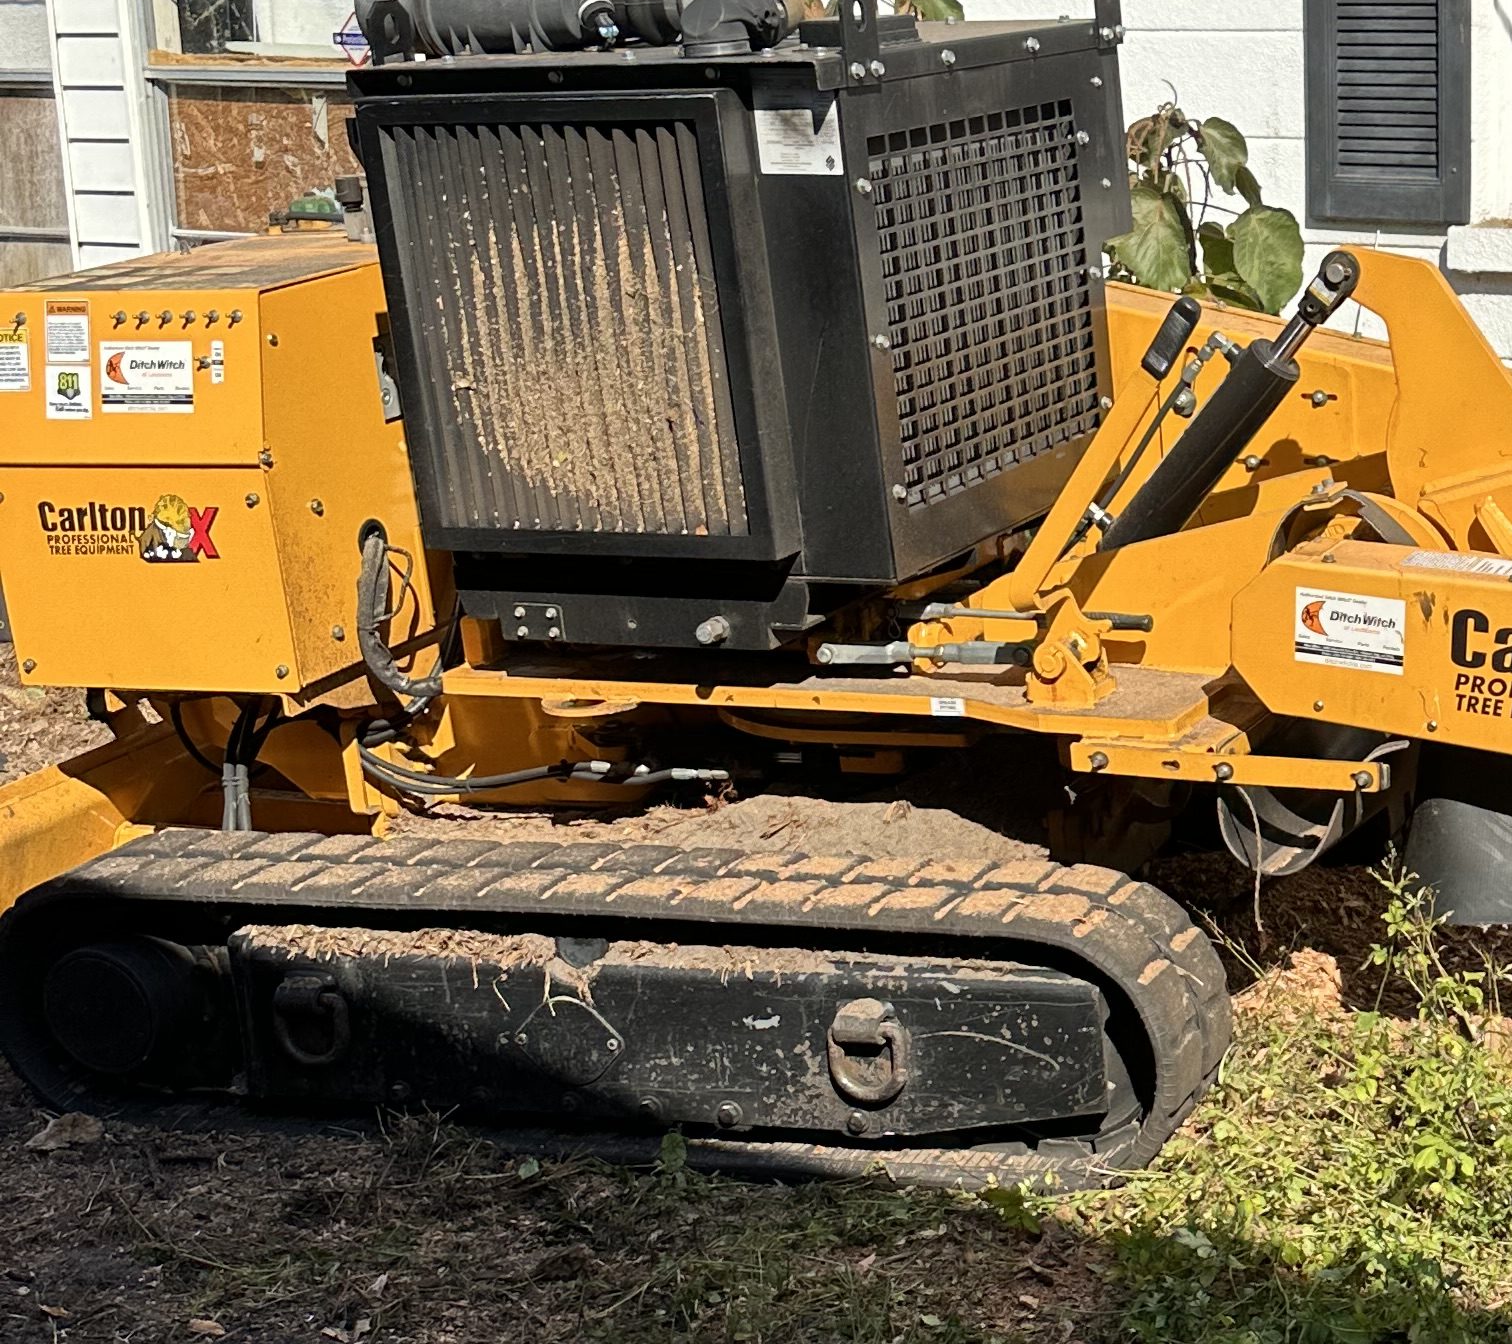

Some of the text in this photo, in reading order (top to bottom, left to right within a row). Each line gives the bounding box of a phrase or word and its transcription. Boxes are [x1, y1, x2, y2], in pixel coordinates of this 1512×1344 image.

[129, 359, 185, 370] Ditch Witch
[58, 372, 79, 390] 811
[38, 501, 146, 533] Carlton
[47, 534, 135, 545] PROFESSIONAL
[50, 544, 135, 556] TREE EQUIPMENT
[1330, 610, 1396, 628] Ditch Witch
[1455, 693, 1503, 718] TREE
